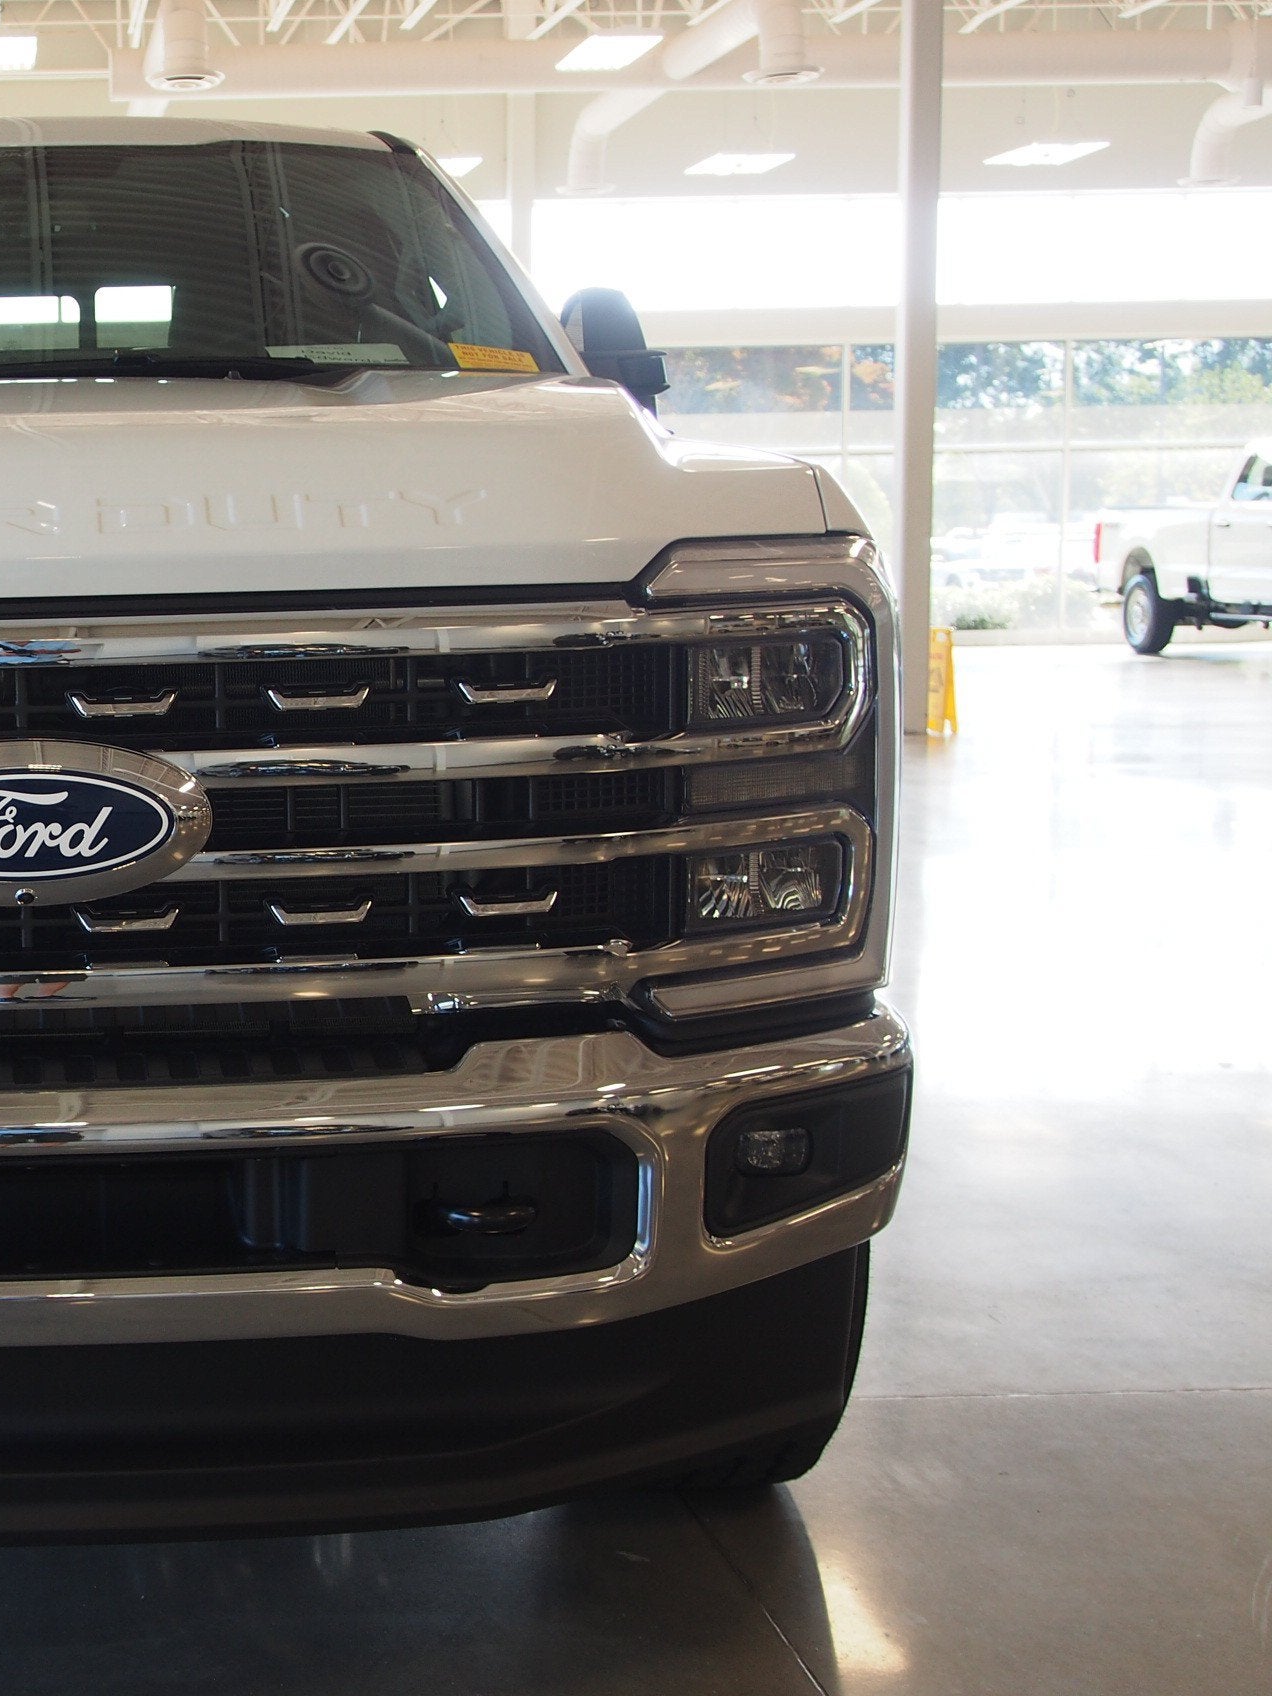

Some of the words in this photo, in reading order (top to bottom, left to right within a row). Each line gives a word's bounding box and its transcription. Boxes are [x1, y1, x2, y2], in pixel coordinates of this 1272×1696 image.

[476, 346, 513, 355] VEHICLE
[482, 352, 500, 360] FOR
[96, 488, 486, 534] DUTY
